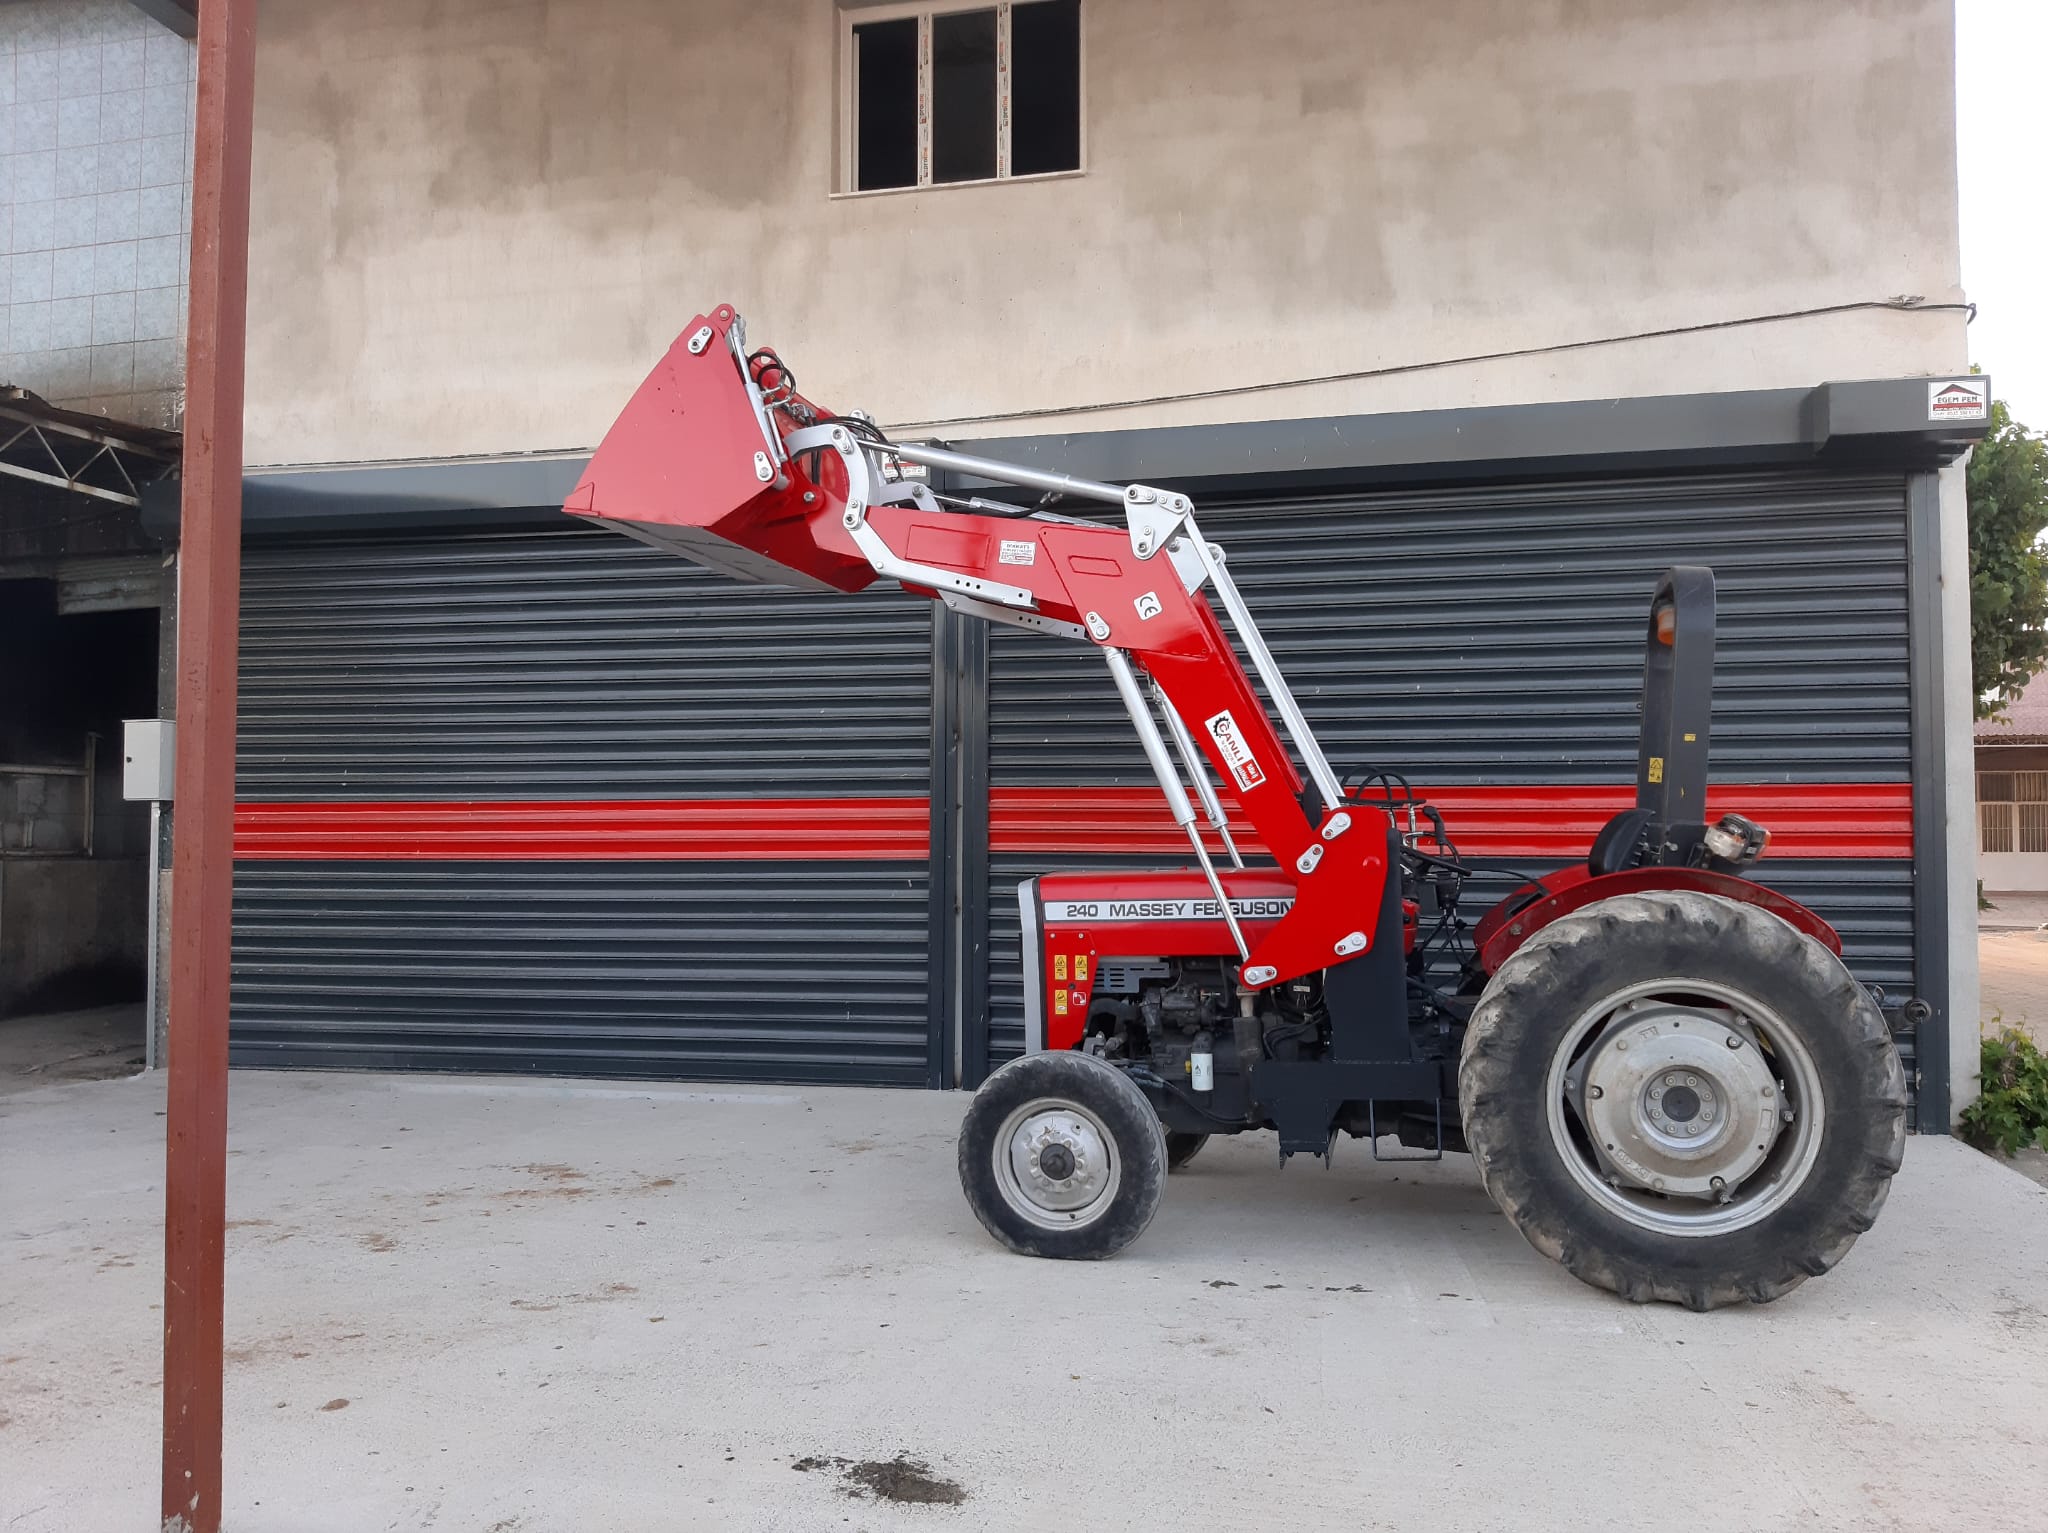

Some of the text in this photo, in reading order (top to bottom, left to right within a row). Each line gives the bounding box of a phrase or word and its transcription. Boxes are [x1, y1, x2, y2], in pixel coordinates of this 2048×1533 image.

[1139, 596, 1159, 617] CE
[1066, 904, 1099, 917] 240
[1109, 903, 1187, 917] MASSEY
